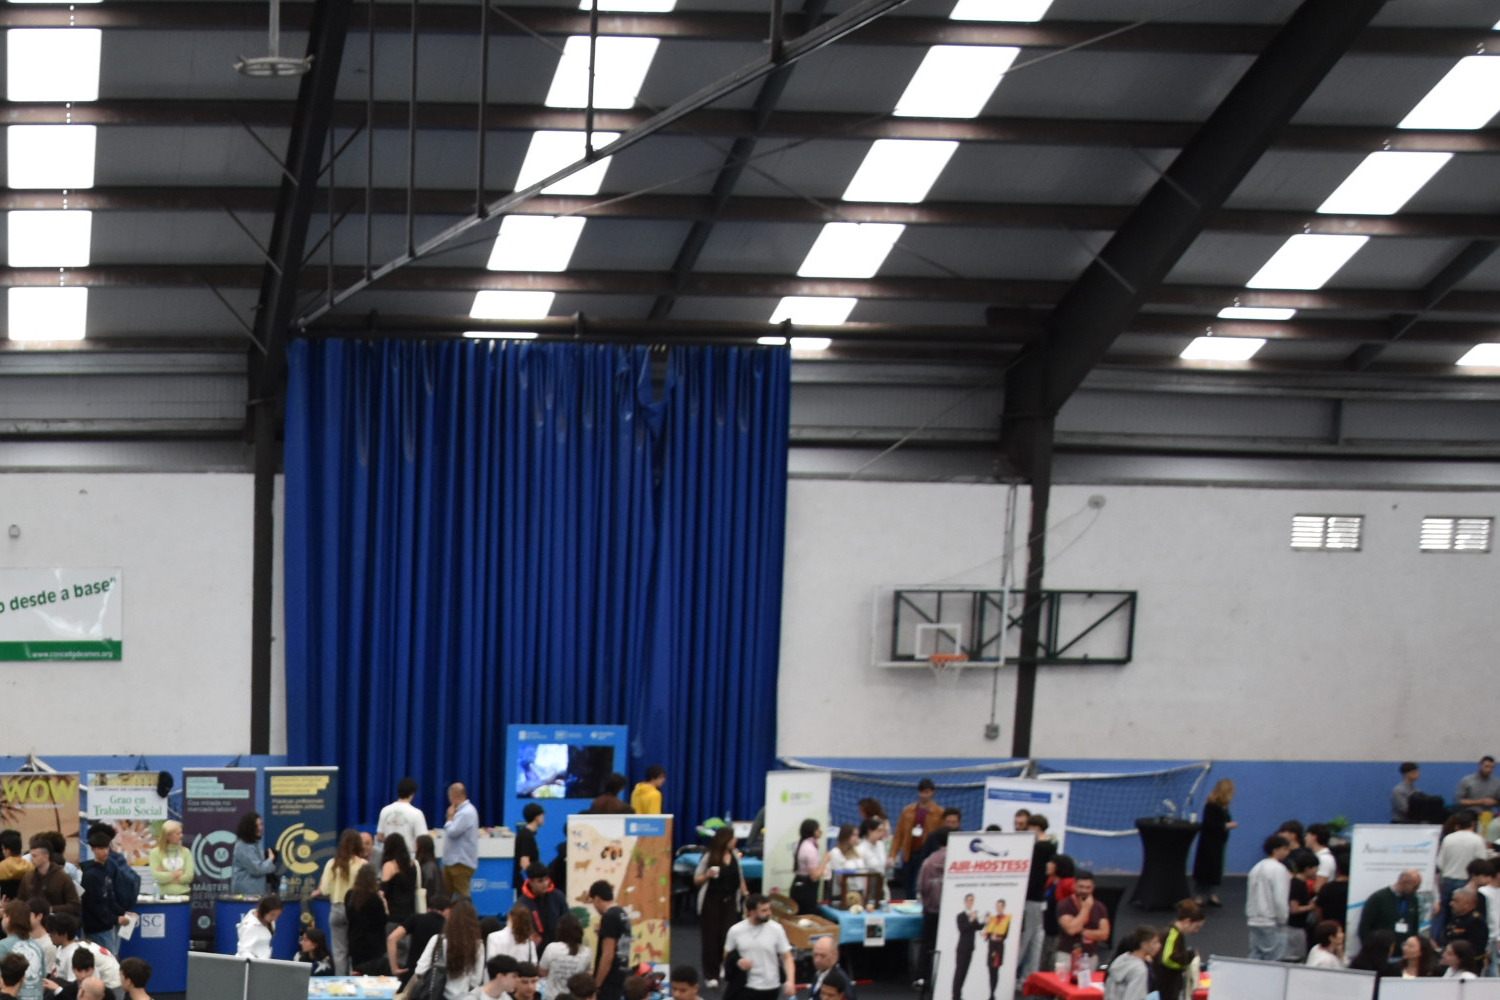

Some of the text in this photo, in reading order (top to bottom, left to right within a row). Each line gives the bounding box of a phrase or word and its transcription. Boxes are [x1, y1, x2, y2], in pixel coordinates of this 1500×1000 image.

[9, 590, 57, 611] desde
[61, 589, 70, 601] a
[73, 577, 116, 598] base"
[2, 779, 77, 803] WOW
[110, 795, 146, 804] Grao en
[94, 805, 162, 816] Traballo Social
[949, 860, 1028, 871] AIR-HOSTESS
[193, 882, 228, 891] MÁSTER
